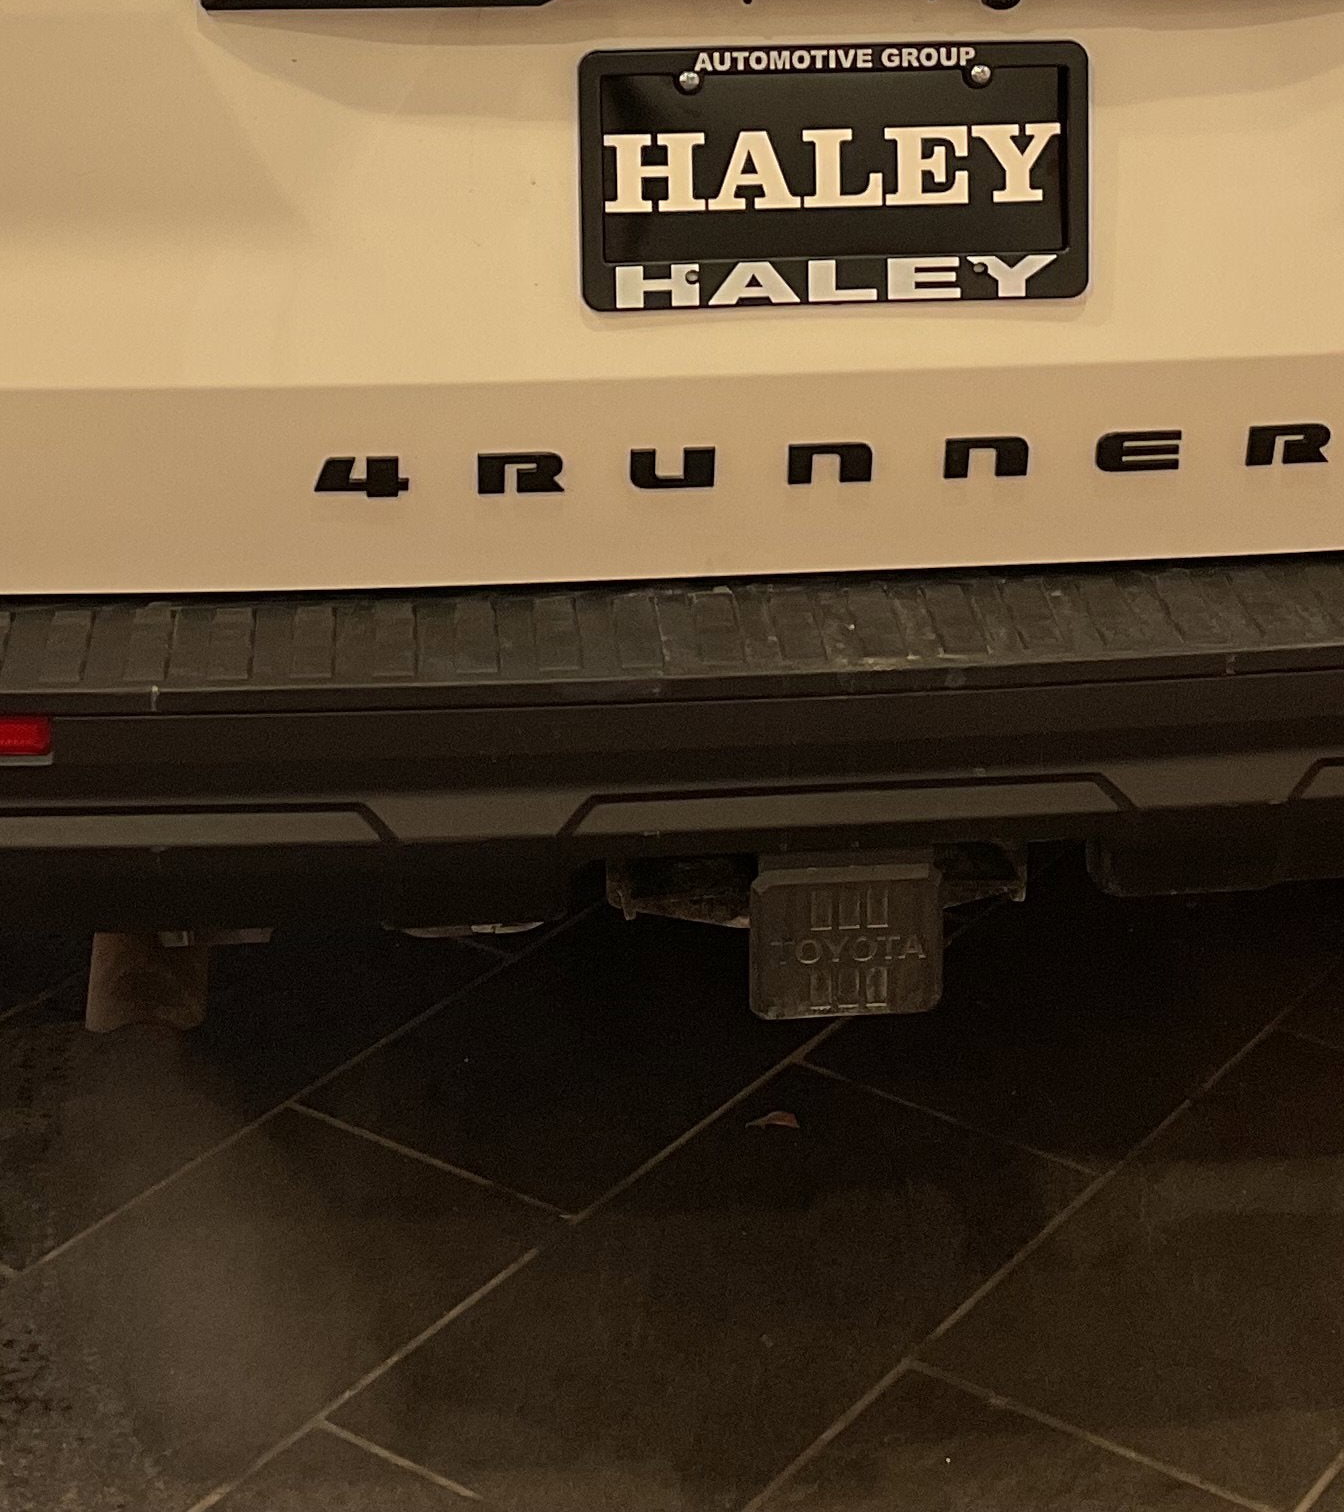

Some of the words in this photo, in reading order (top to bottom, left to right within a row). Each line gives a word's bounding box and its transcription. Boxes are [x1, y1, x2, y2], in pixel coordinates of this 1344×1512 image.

[693, 48, 874, 73] AUTOMOTIVE
[880, 46, 976, 69] GROUP
[603, 121, 1061, 214] HALEY
[615, 253, 1058, 309] HALEY
[769, 936, 927, 966] TOYOTA
